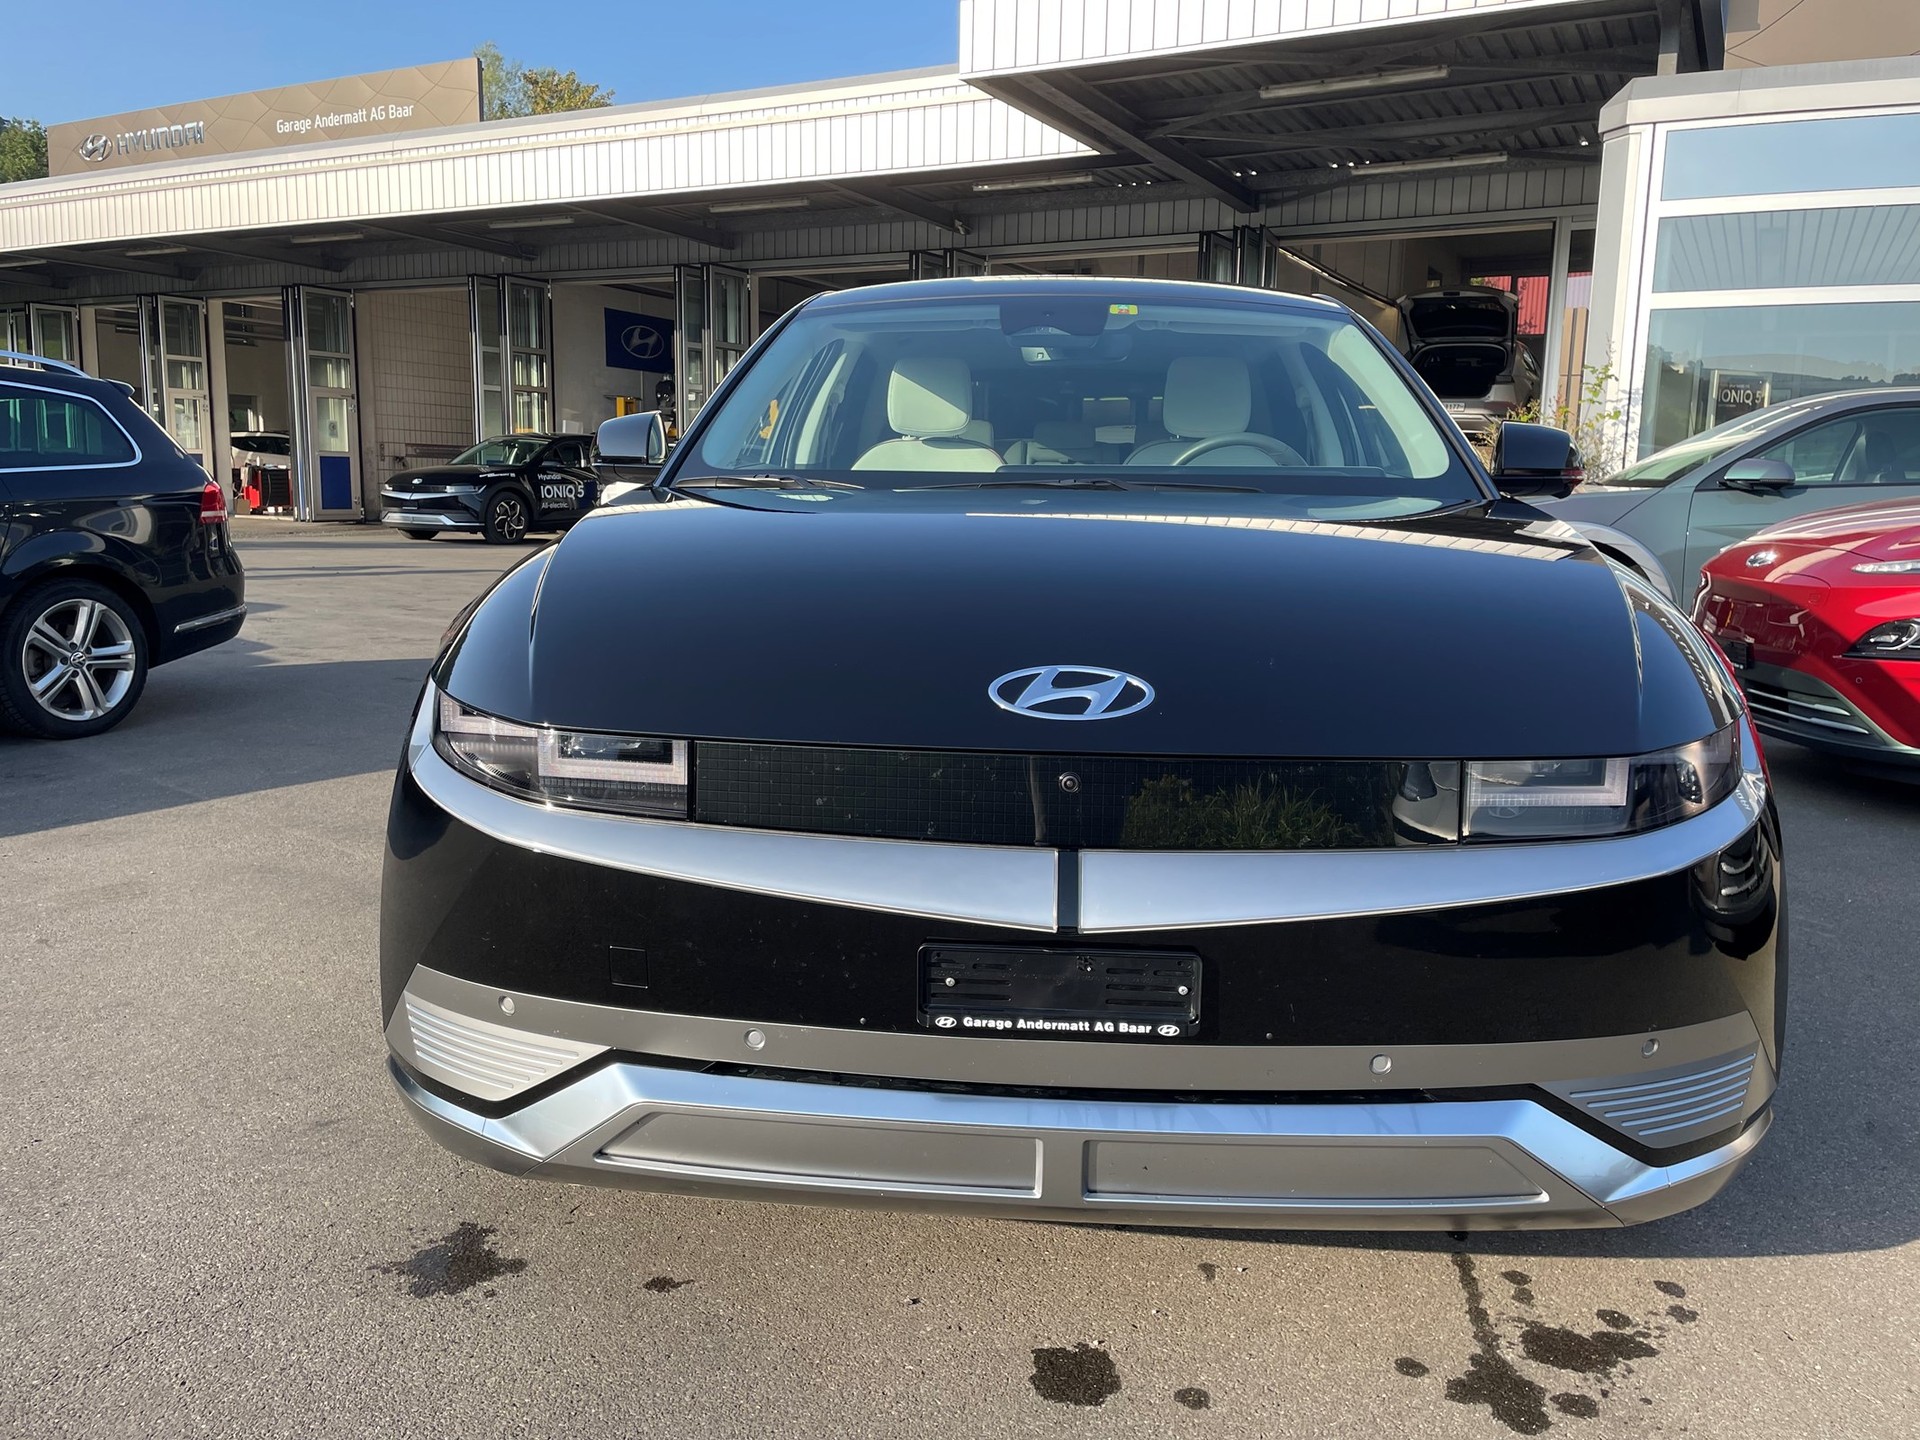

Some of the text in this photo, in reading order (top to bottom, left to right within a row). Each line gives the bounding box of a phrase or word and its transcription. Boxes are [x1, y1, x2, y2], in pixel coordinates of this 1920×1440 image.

[276, 103, 414, 134] Garage Andermatt AG Baar
[116, 120, 205, 156] HYUNDAI
[540, 485, 576, 500] IONIQ
[577, 485, 585, 498] 5
[963, 1016, 1152, 1034] Garage Andermatt AG Baar
